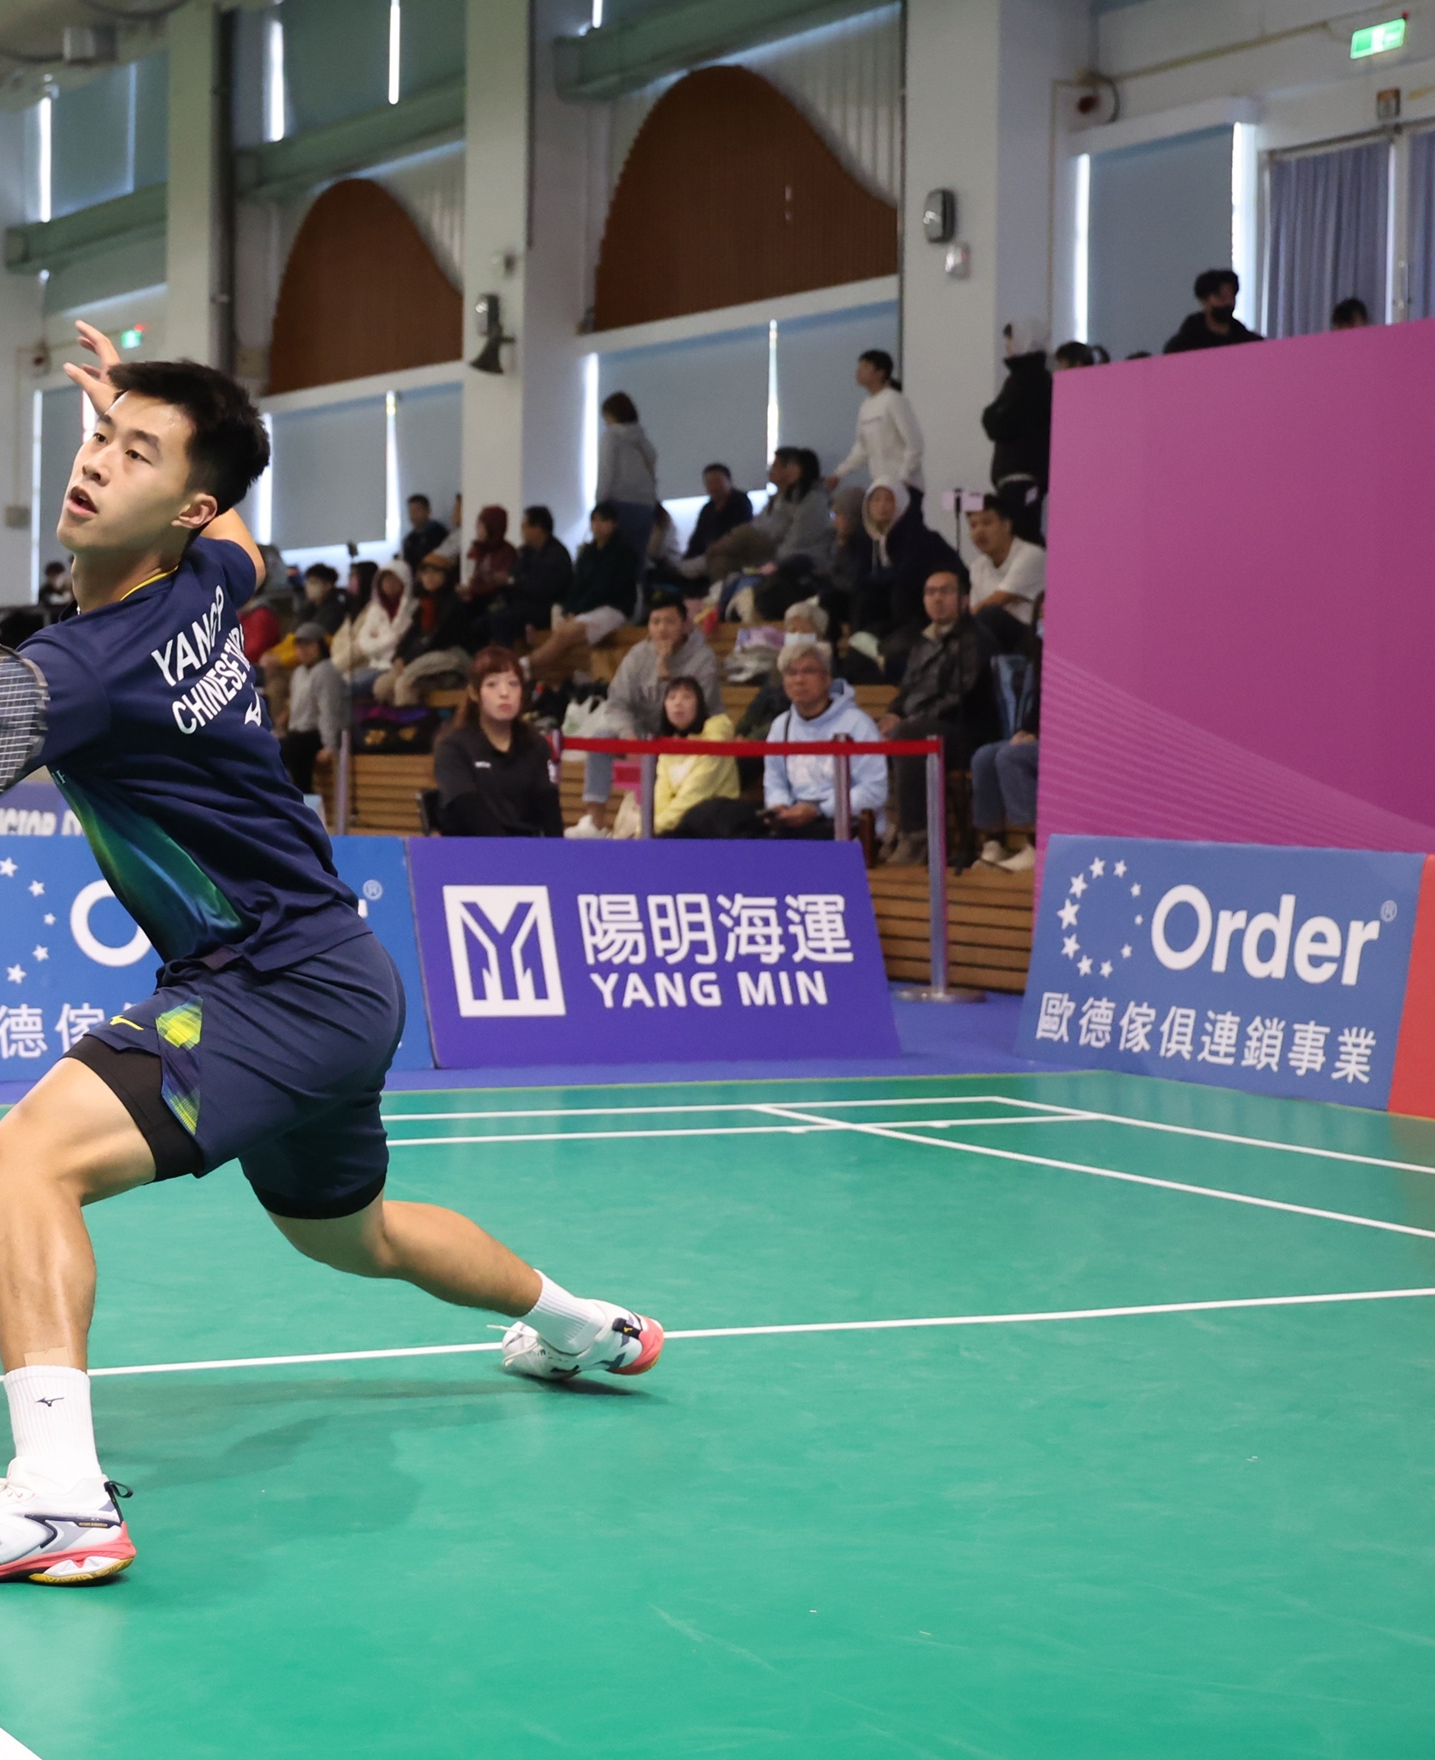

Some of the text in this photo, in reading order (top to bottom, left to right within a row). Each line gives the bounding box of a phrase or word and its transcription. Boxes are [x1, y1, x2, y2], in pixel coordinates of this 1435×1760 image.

[172, 652, 247, 734] CHINESE
[577, 892, 854, 965] 陽明海運
[590, 970, 828, 1008] YANG MIN
[1035, 991, 1376, 1085] 歐德傢俱連鎖事業
